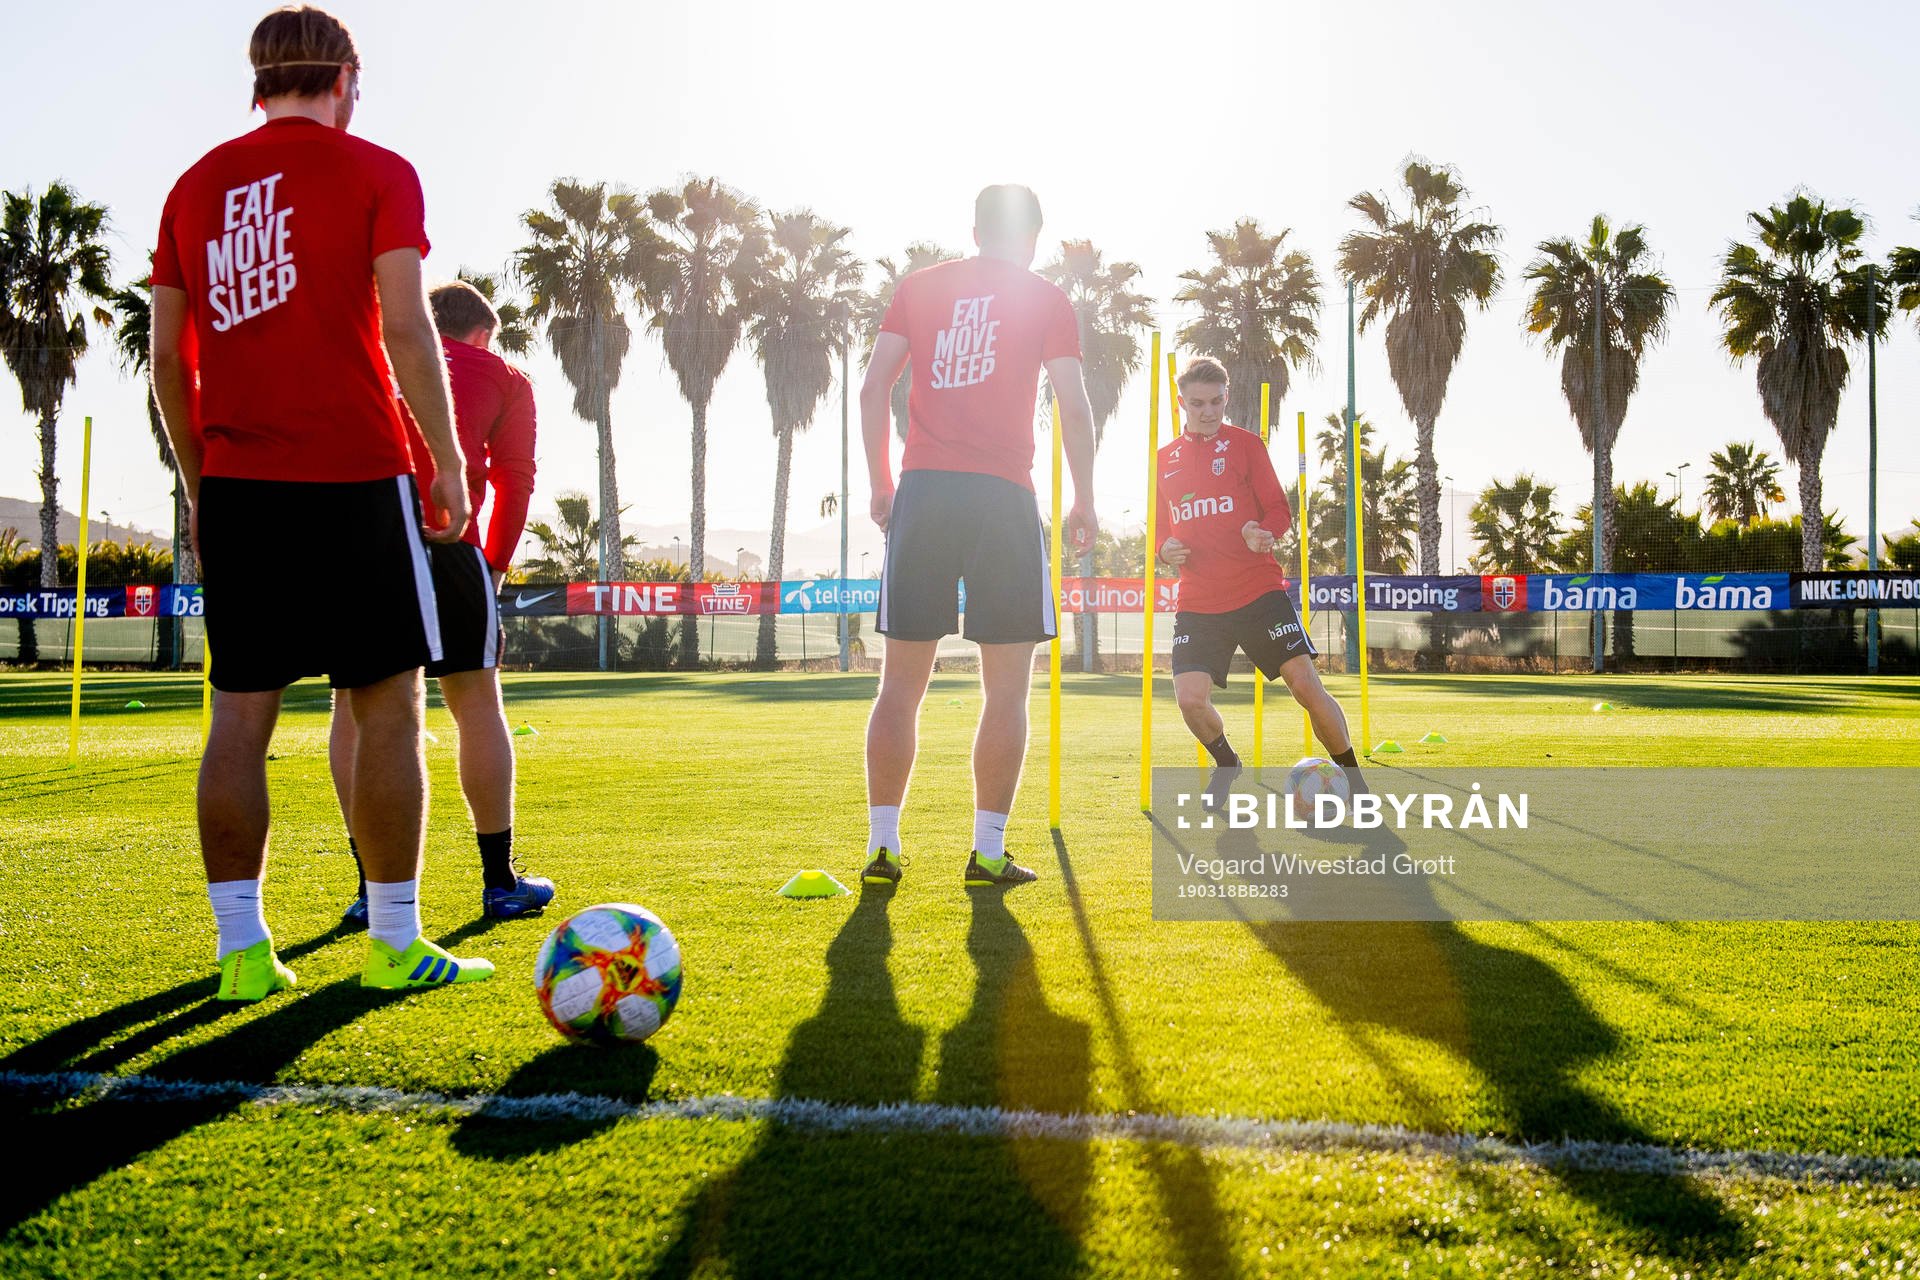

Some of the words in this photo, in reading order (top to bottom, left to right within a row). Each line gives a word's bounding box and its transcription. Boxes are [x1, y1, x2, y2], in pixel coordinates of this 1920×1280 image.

[224, 172, 283, 232] EAT
[206, 206, 294, 288] MOVE
[208, 263, 297, 332] SLEEP
[952, 294, 995, 329] EAT
[934, 320, 1000, 364] MOVE
[930, 353, 995, 389] SLEEP
[0, 593, 38, 612] orsk
[172, 588, 204, 616] ba
[586, 586, 677, 612] TINE
[706, 598, 745, 610] TINE
[1369, 582, 1459, 610] Tipping
[1173, 634, 1190, 645] ma
